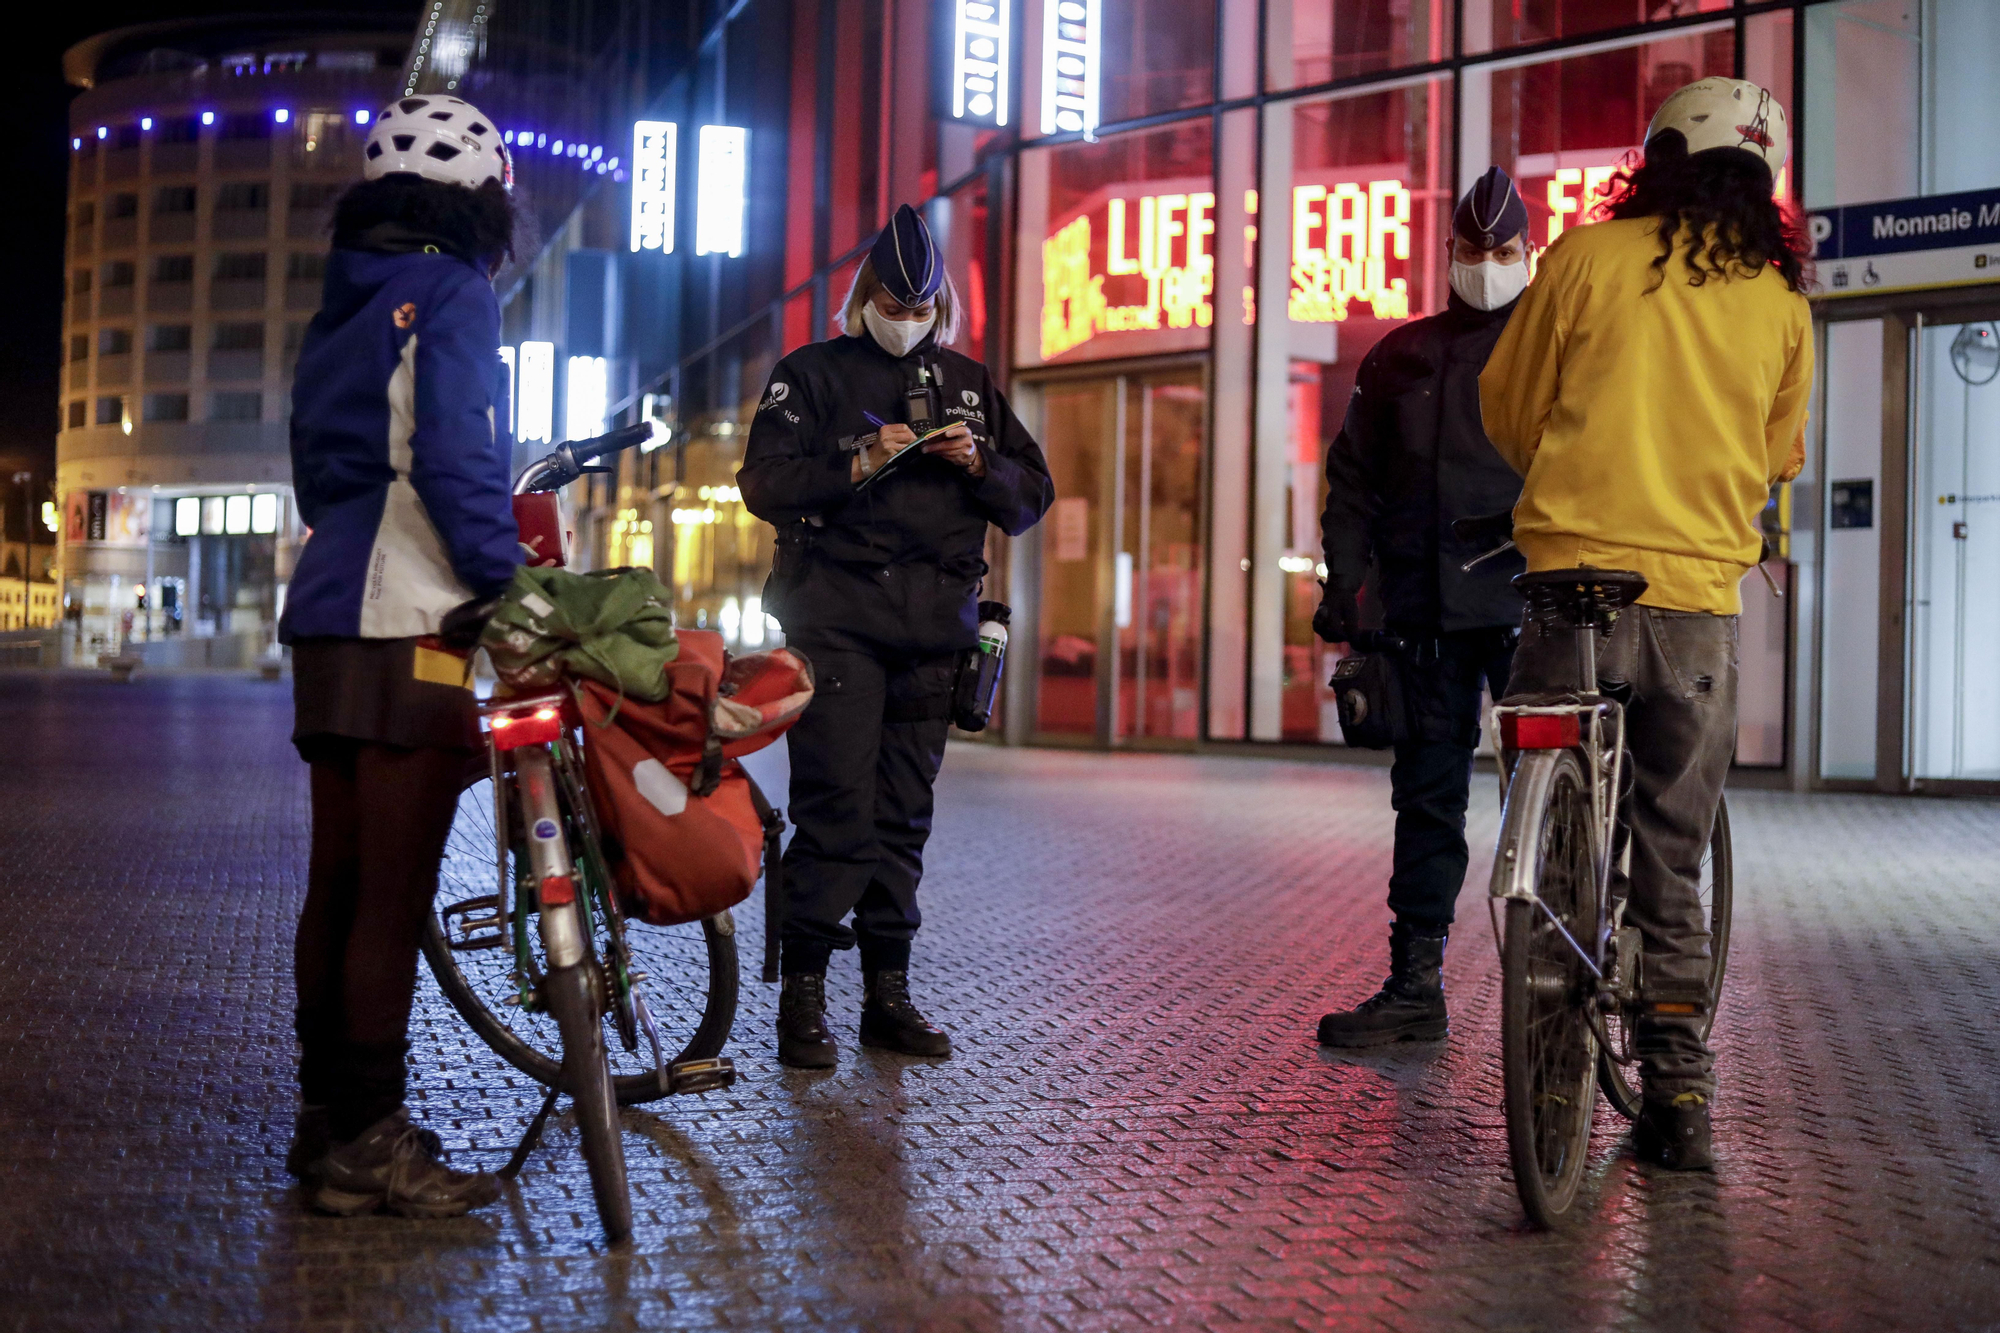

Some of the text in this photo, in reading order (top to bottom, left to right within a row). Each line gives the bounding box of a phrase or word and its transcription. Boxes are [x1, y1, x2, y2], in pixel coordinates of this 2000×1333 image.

[1107, 192, 1215, 275] LIFE
[1244, 179, 1410, 264] EAR
[1873, 202, 2000, 240] Monnaie M
[945, 406, 975, 418] Politie
